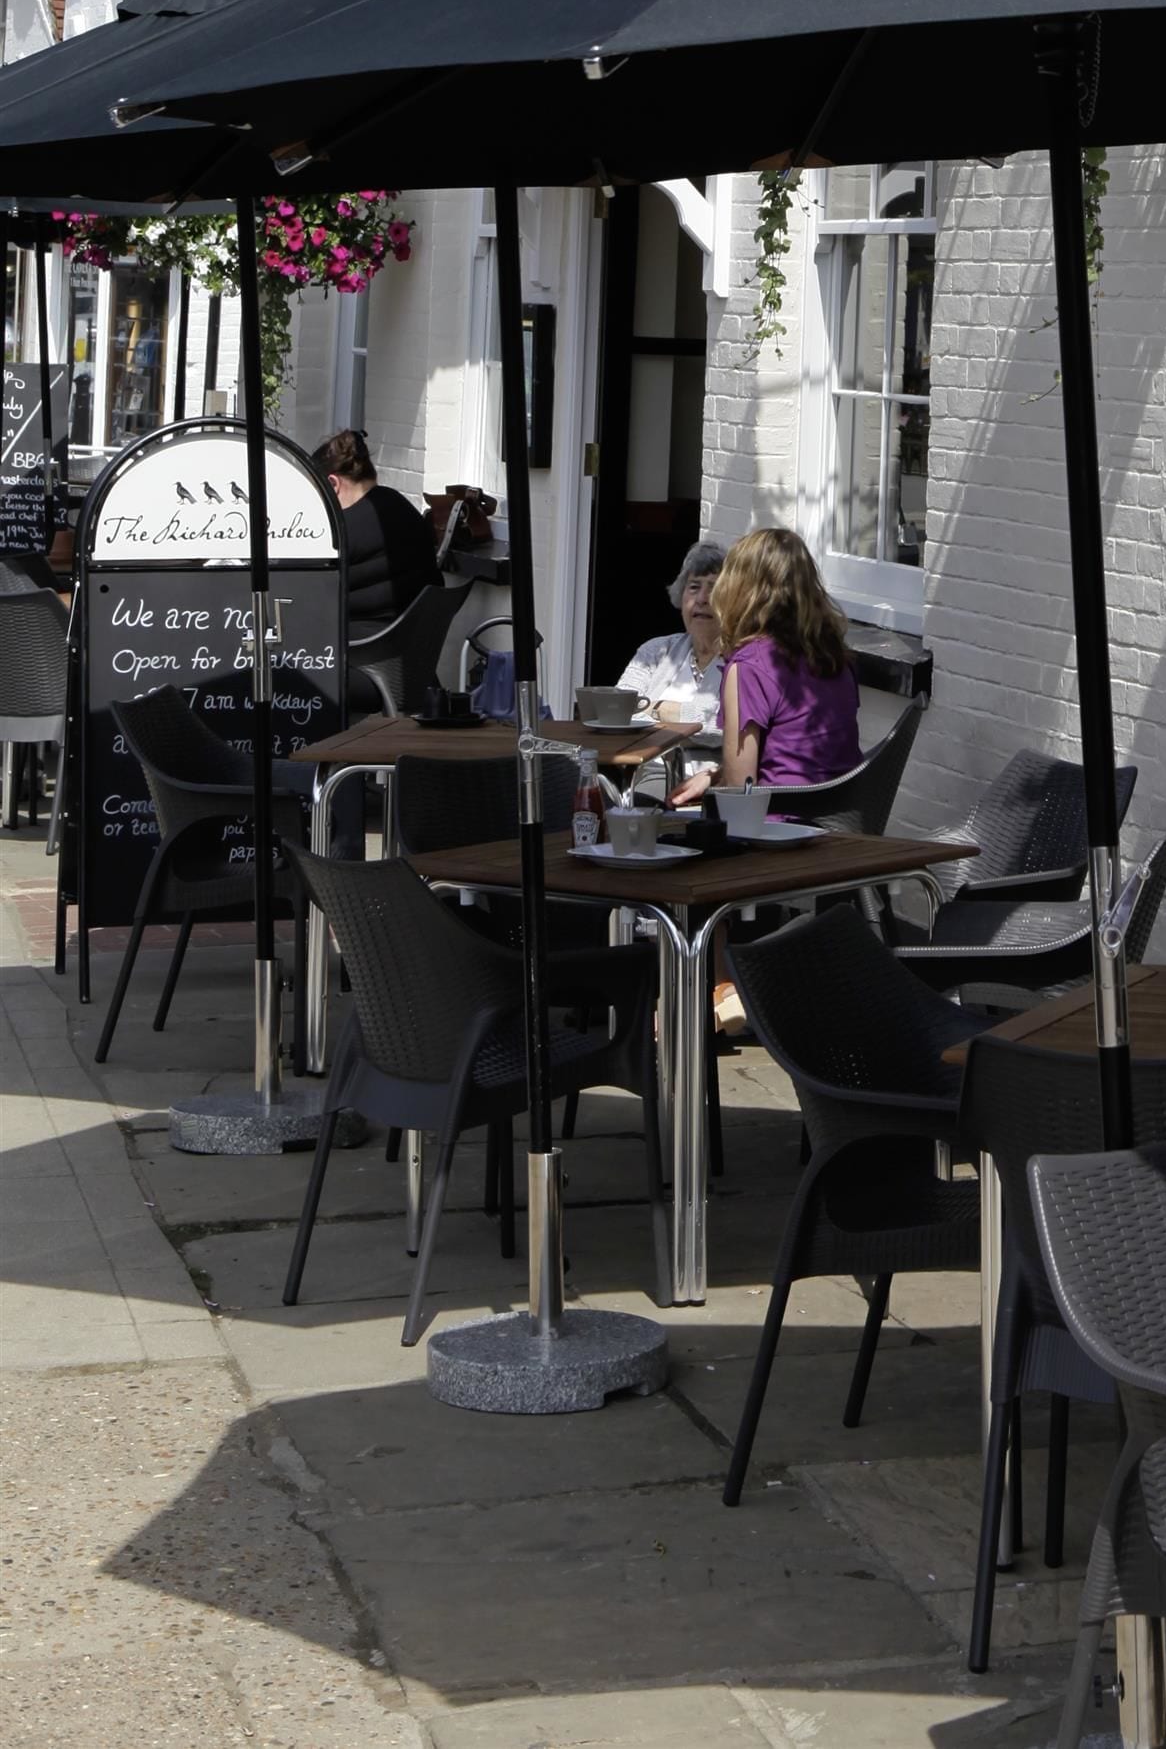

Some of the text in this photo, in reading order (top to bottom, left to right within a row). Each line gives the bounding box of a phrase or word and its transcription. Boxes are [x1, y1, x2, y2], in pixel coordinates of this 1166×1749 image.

[2, 396, 24, 419] uly
[0, 511, 17, 521] ead
[103, 510, 325, 545] The Richard nslow
[111, 598, 154, 628] We
[165, 608, 210, 630] are
[112, 645, 335, 681] Open for brakfast
[182, 687, 199, 710] 7
[203, 694, 237, 711] am
[102, 794, 157, 815] Come
[103, 822, 125, 837] or
[228, 846, 280, 864] paps
